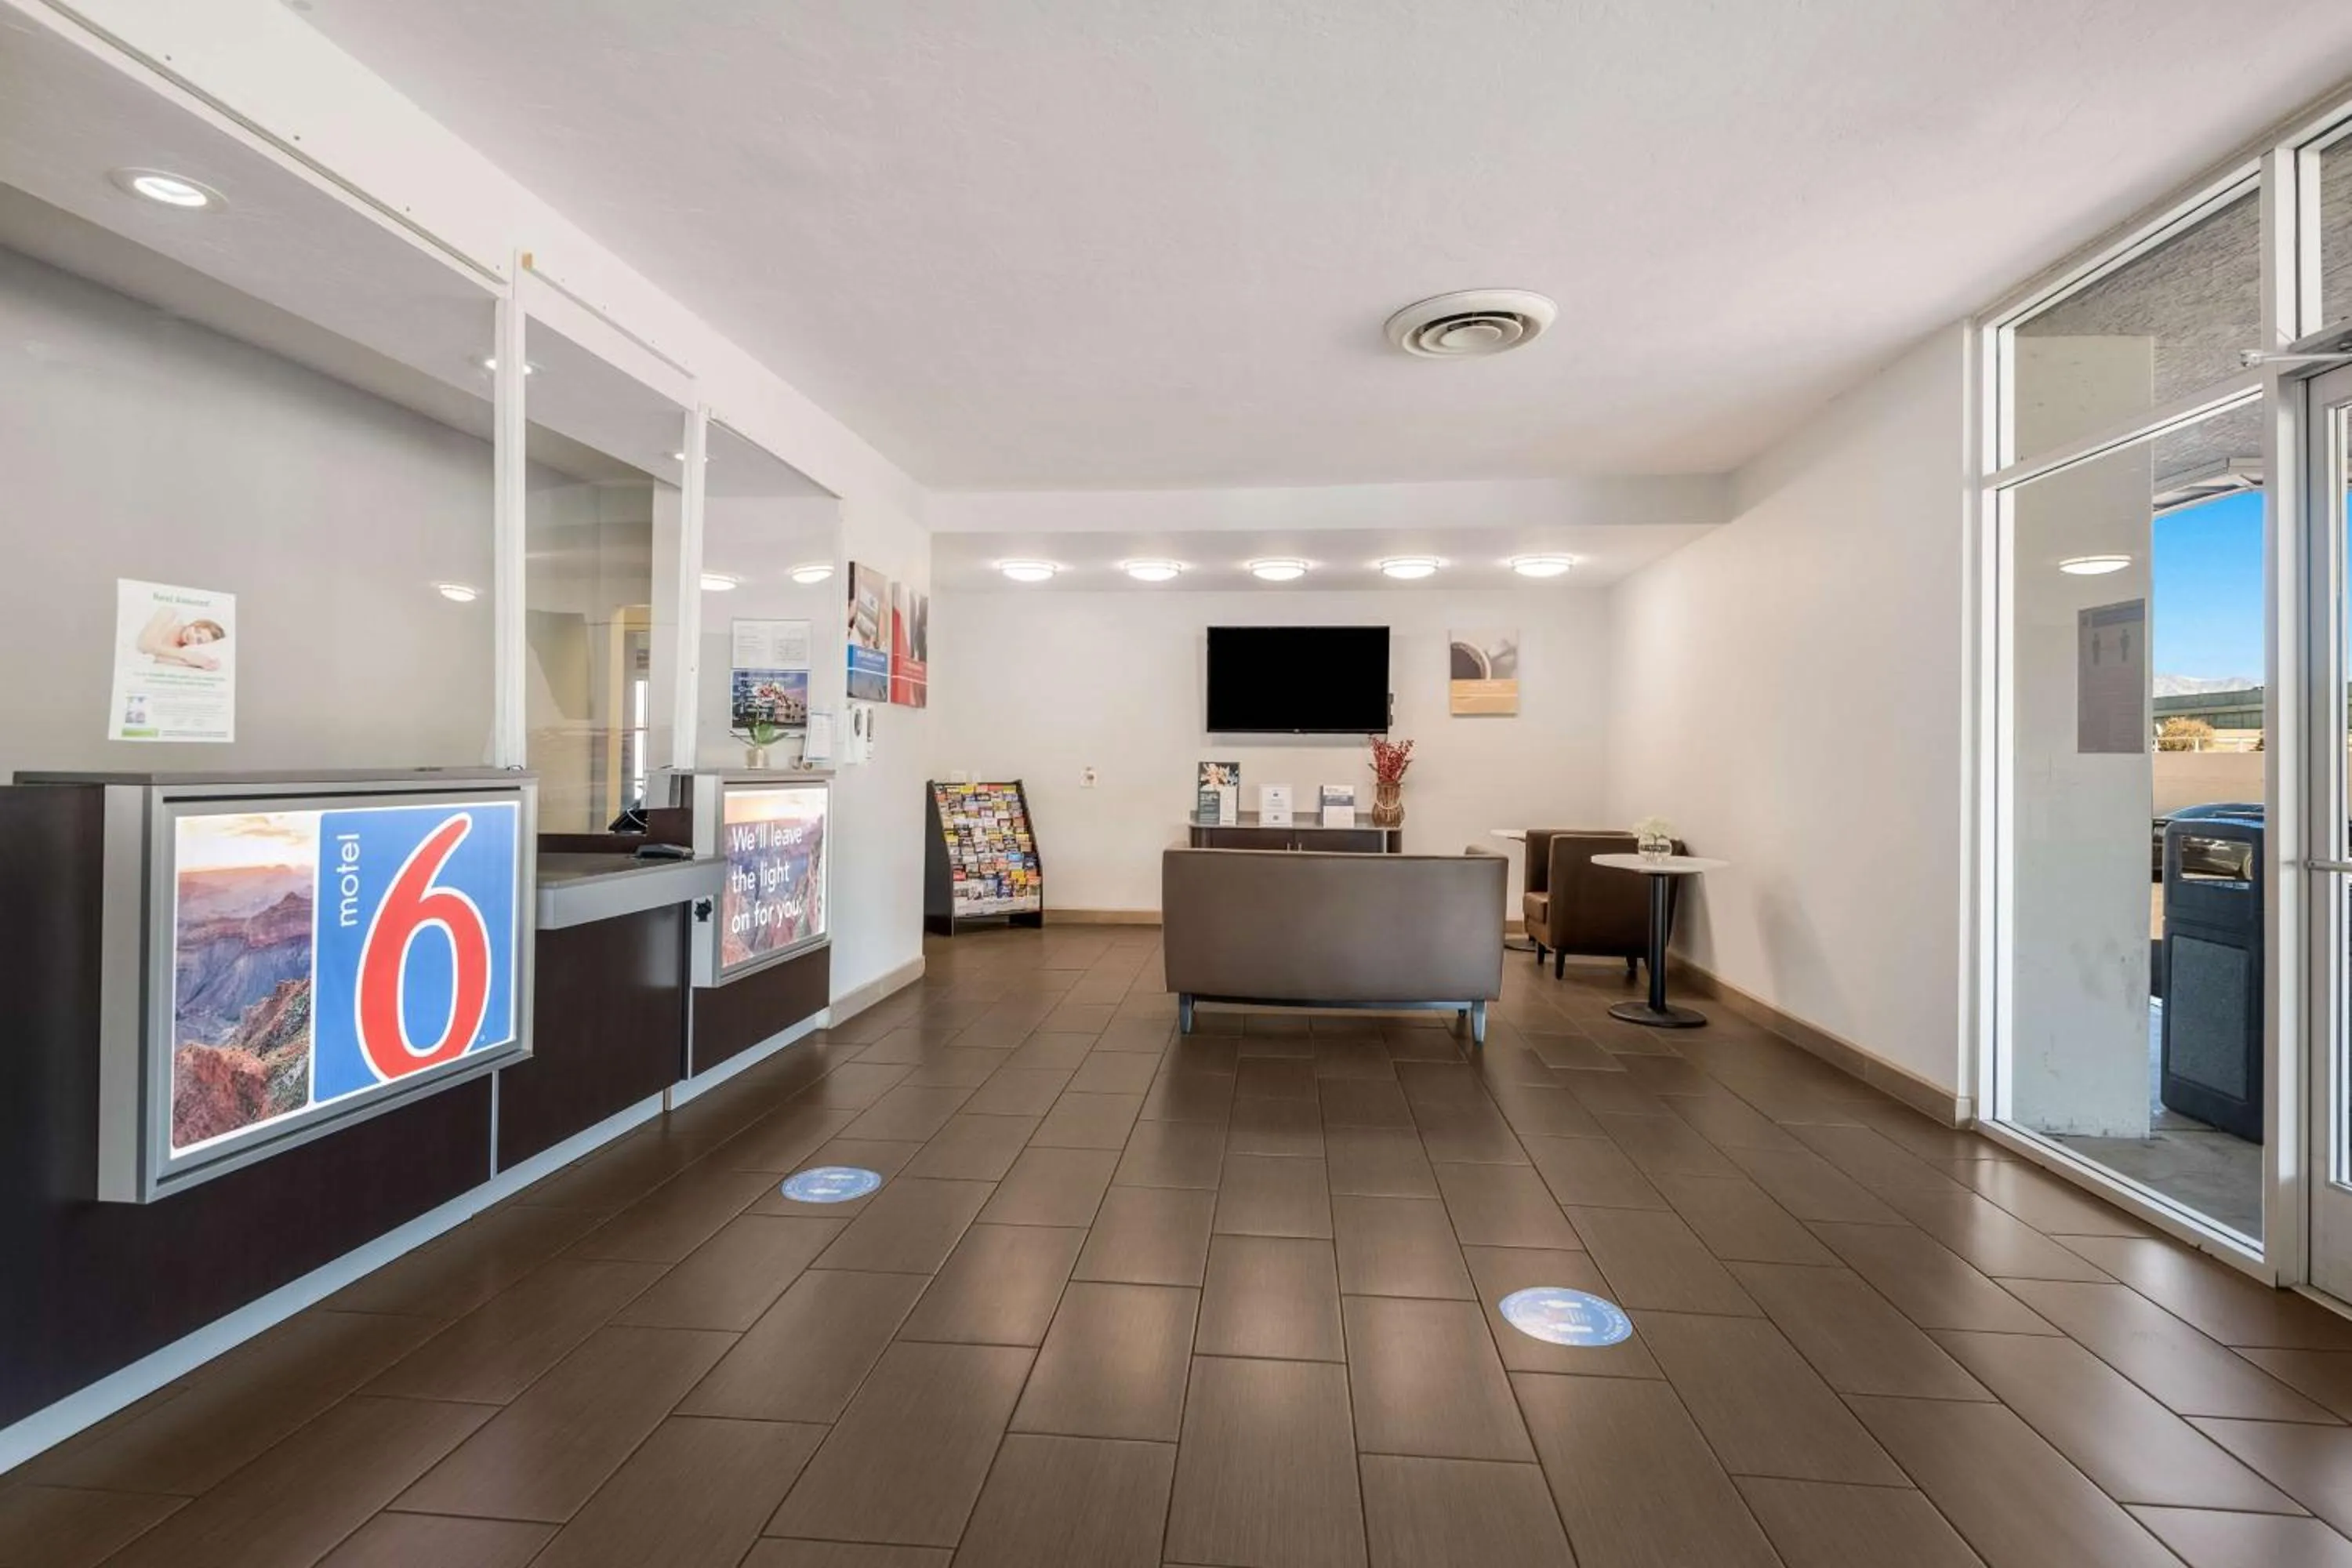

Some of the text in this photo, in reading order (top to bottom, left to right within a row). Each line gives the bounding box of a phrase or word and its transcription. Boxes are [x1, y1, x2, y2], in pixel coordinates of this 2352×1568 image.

[732, 821, 802, 852] We'll leave
[336, 833, 361, 927] motel
[731, 858, 789, 893] the light
[731, 912, 750, 934] on
[753, 900, 773, 927] for
[354, 811, 492, 1083] 6
